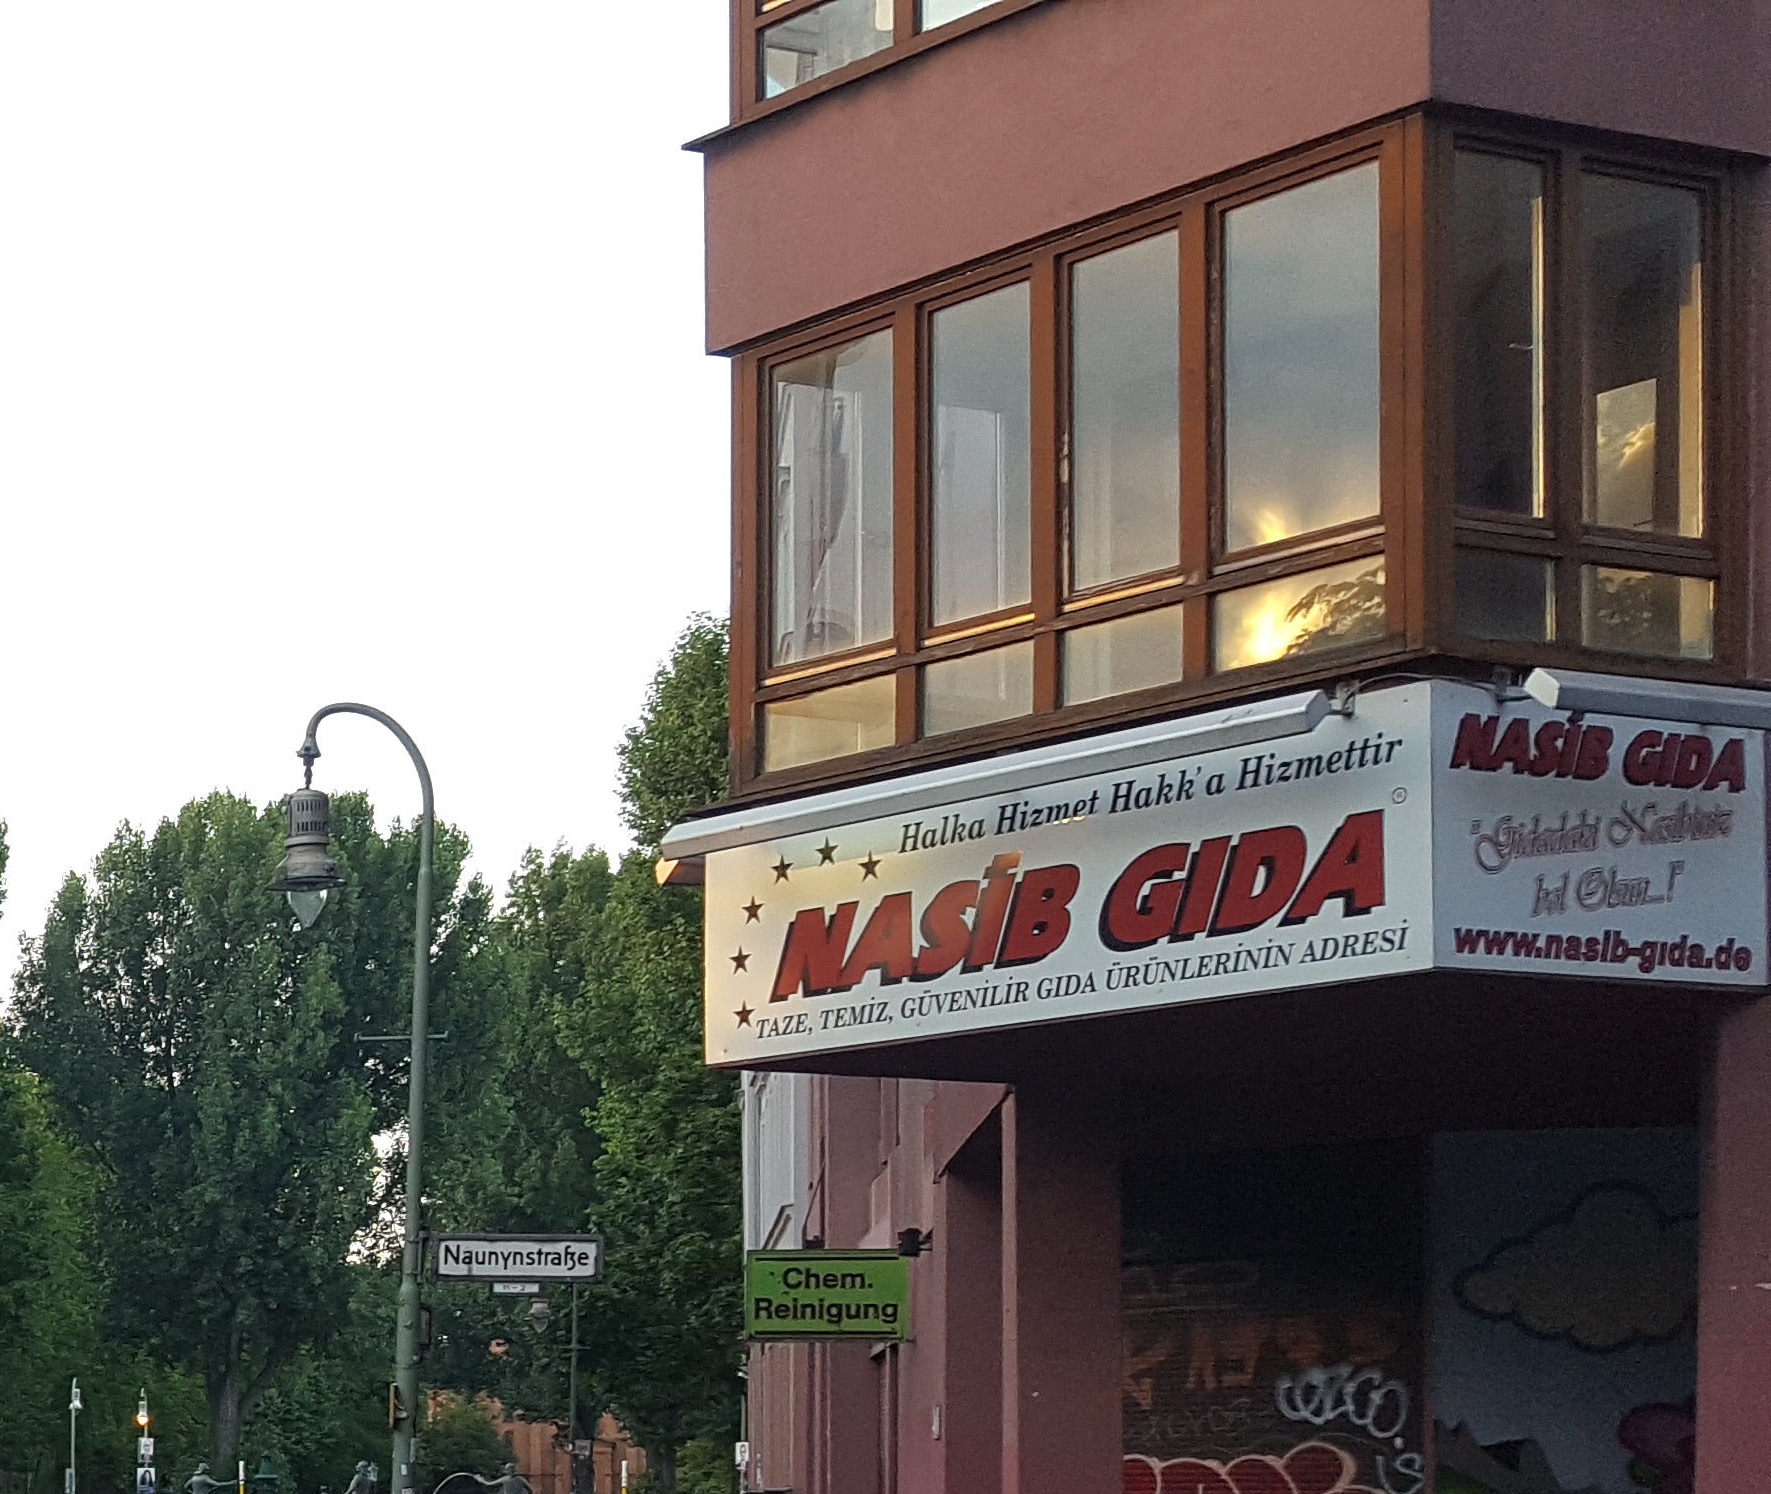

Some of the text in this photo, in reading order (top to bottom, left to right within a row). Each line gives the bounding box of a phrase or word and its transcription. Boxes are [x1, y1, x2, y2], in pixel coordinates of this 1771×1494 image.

[1622, 729, 1747, 793] GIDA
[899, 813, 985, 855] Halka
[994, 790, 1101, 836] Hizmet
[1235, 733, 1404, 792] Hizmettir
[769, 808, 1387, 1004] NASİB GIDA
[756, 918, 1411, 1040] TAZE, TEMİZ, GÜVENİLİR GIDA ÜRÜNLERİNİN ADRESİ
[443, 1244, 590, 1271] Naunynstraße
[782, 1267, 874, 1290] Chem.
[754, 1296, 899, 1325] Reinigung
